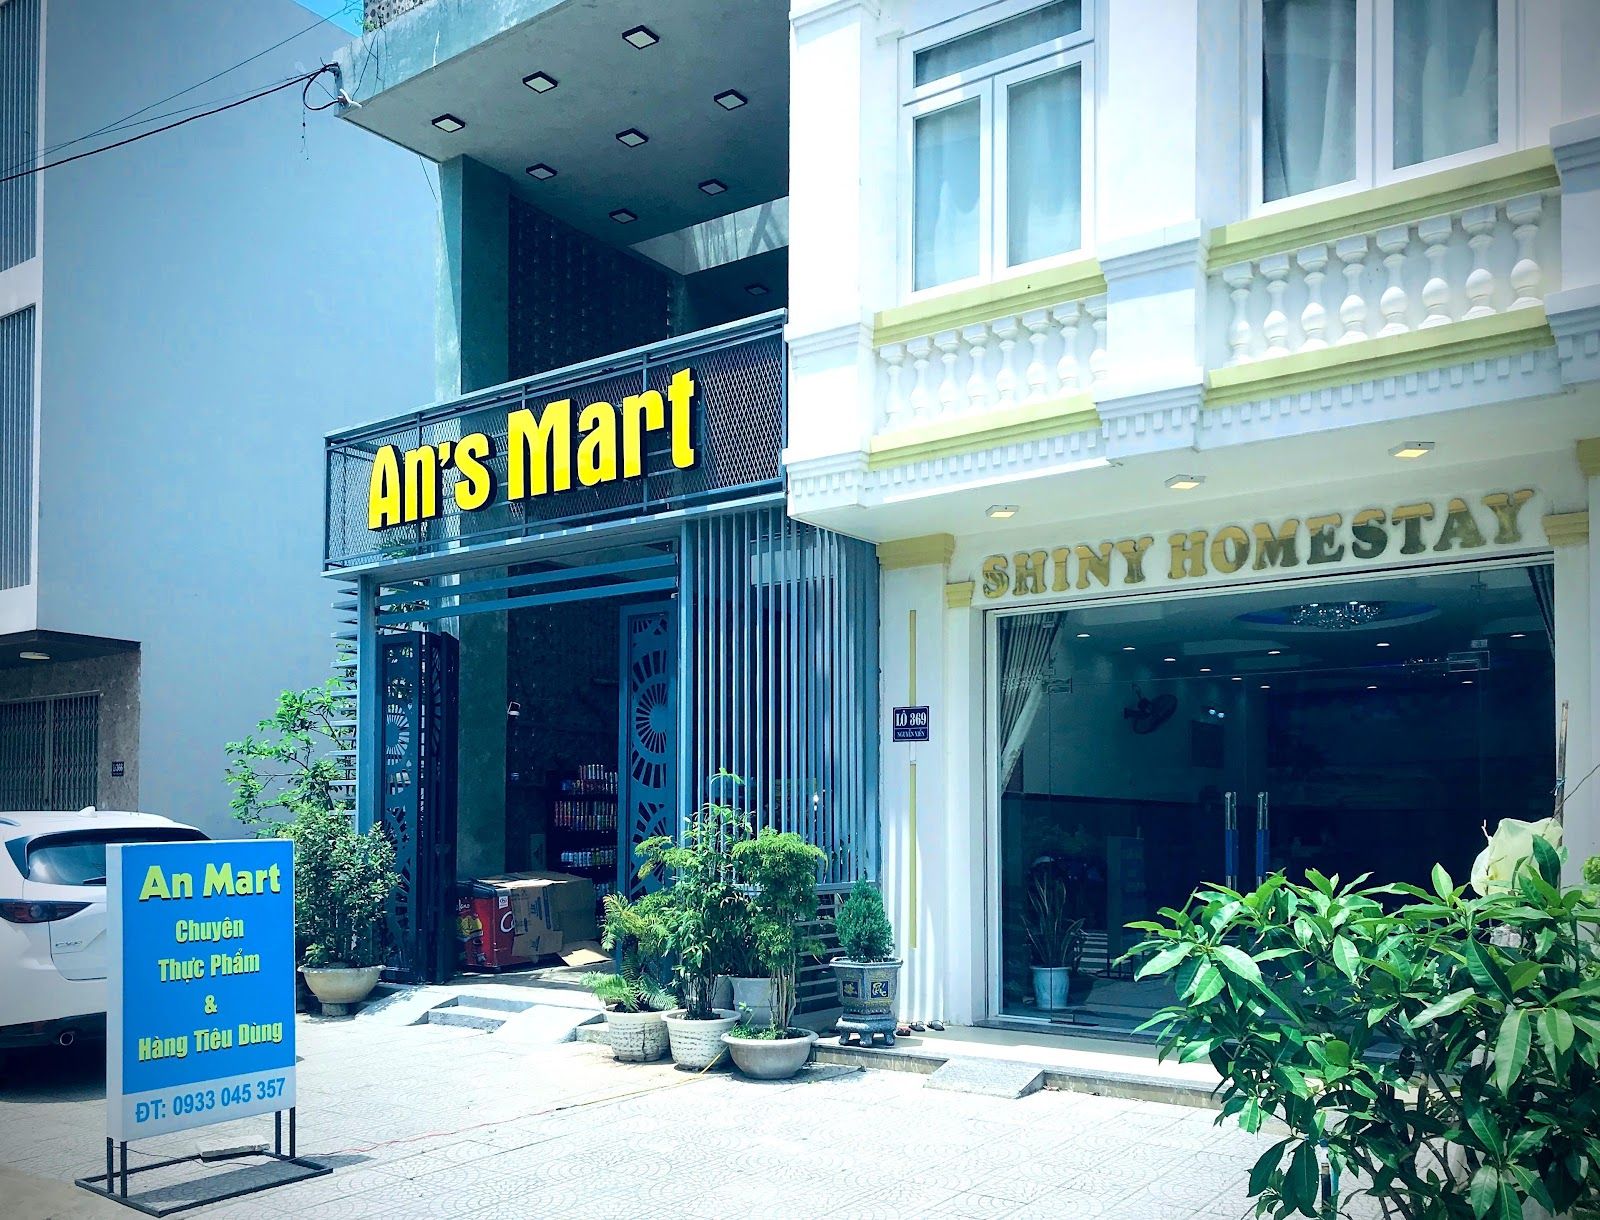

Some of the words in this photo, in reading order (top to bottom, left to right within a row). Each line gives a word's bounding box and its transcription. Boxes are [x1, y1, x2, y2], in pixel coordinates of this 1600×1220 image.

[368, 432, 491, 530] An's
[507, 367, 695, 501] Mart
[983, 536, 1154, 598] SHINY
[1167, 488, 1534, 580] HOMESTAY
[909, 712, 927, 726] 369
[139, 865, 193, 900] An
[203, 862, 281, 897] Mart
[175, 917, 244, 943] Chuyên
[158, 957, 205, 984] Thực
[210, 948, 260, 976] Phẩm
[204, 995, 218, 1014] &
[138, 1035, 188, 1062] Hàng
[194, 1028, 232, 1052] Tiêu
[238, 1021, 283, 1046] Dùng
[135, 1101, 166, 1123] ĐT:
[173, 1091, 215, 1116] 0933
[221, 1083, 251, 1107] 045
[257, 1077, 286, 1100] 357
